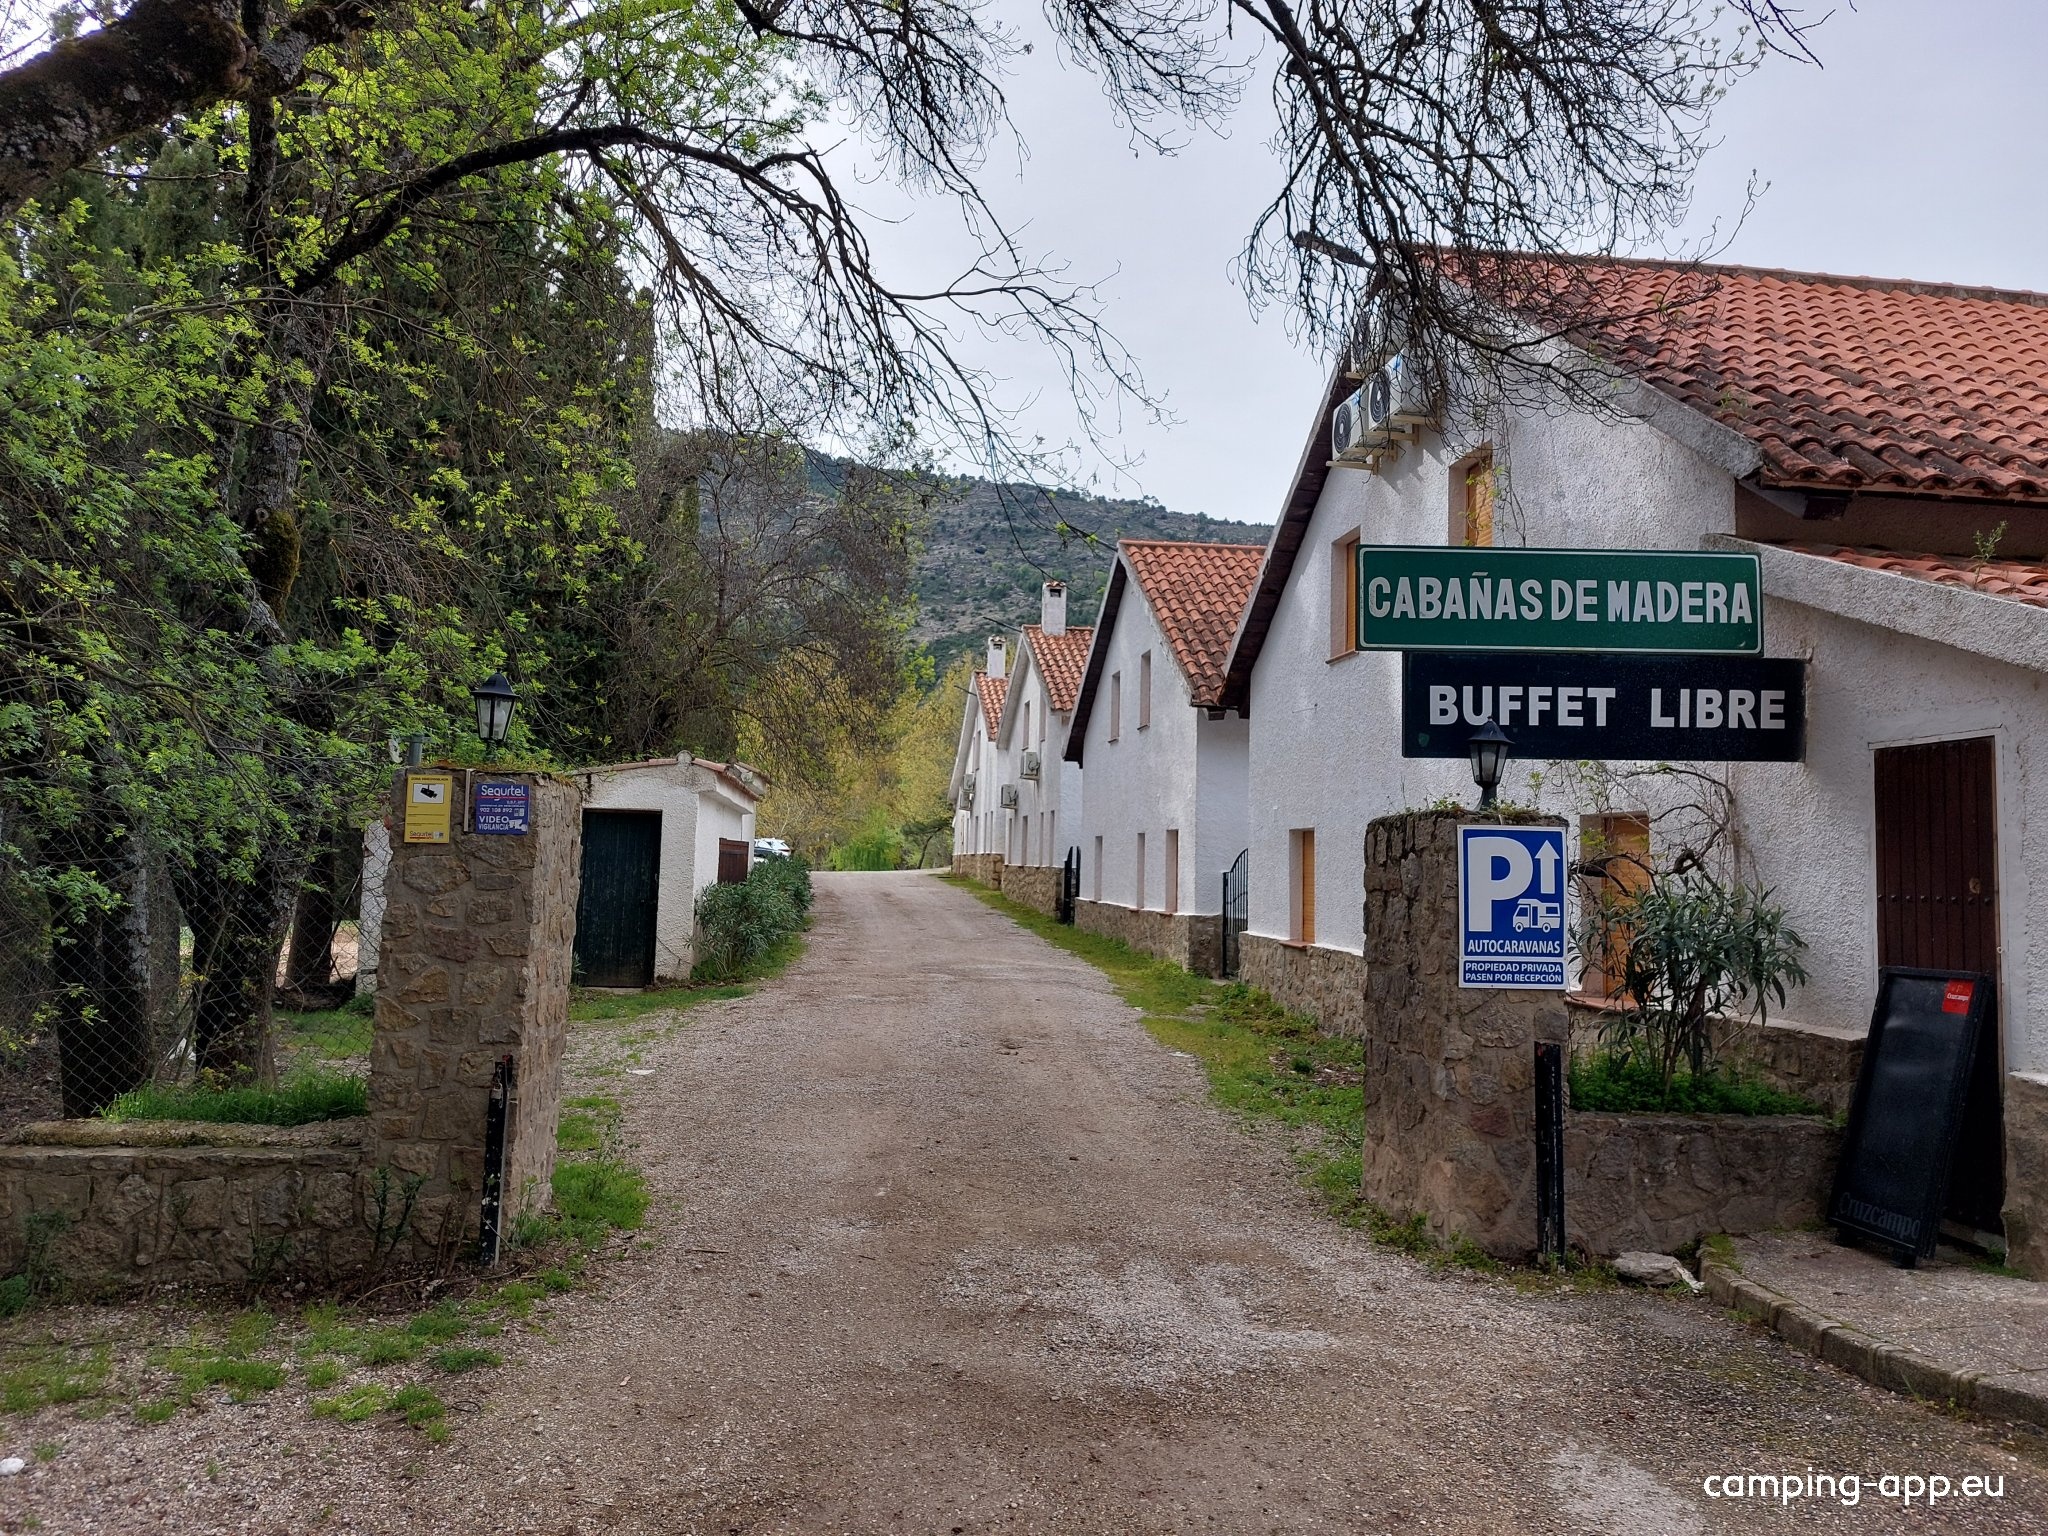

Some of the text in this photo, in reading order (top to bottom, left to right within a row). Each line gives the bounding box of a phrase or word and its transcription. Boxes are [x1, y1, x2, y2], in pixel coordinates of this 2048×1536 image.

[1368, 571, 1753, 624] CABAÑAS DE MADERA
[1429, 684, 1786, 730] BUFFET LIBRE
[481, 785, 526, 801] Segurtel
[478, 823, 509, 831] VIGILANCIA
[479, 815, 509, 824] VIDEO
[1467, 836, 1534, 932] P
[1467, 939, 1561, 954] AUTOCARAVANAS
[1465, 962, 1562, 973] PROPIEDAD PRIVADA
[1465, 972, 1562, 983] PASEN POR RECEPCIÓN
[1838, 1191, 1921, 1239] Cruzcampo
